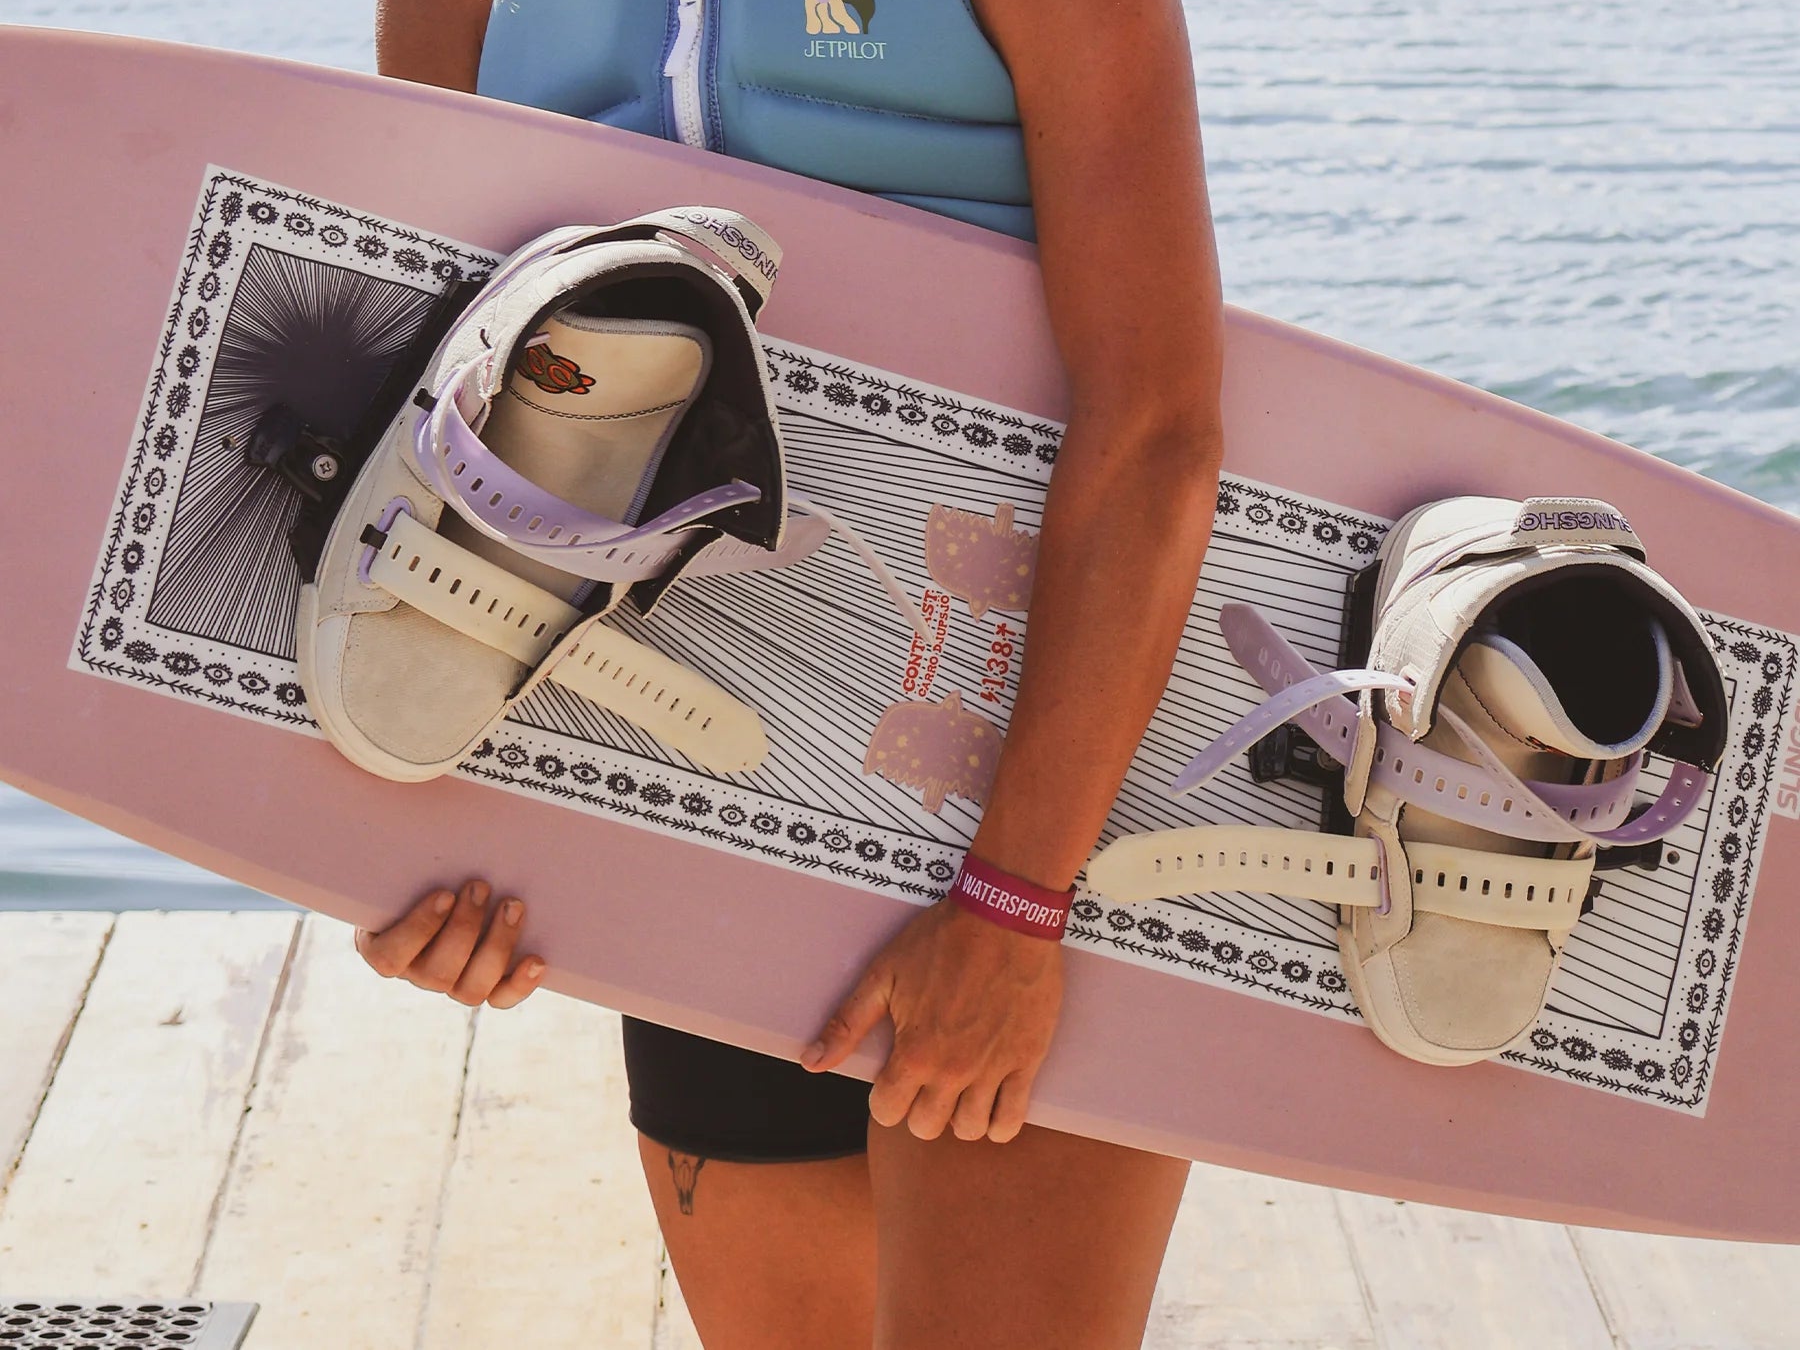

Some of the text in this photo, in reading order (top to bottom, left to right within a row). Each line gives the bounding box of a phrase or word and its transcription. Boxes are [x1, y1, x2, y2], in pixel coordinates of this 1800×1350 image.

[804, 40, 887, 59] JETPILOT
[668, 212, 779, 281] INGSHOT
[1511, 511, 1633, 535] SLINGSHO
[918, 656, 939, 697] CARRO
[982, 641, 1013, 690] 138
[962, 872, 1064, 927] WATERSPORTS
